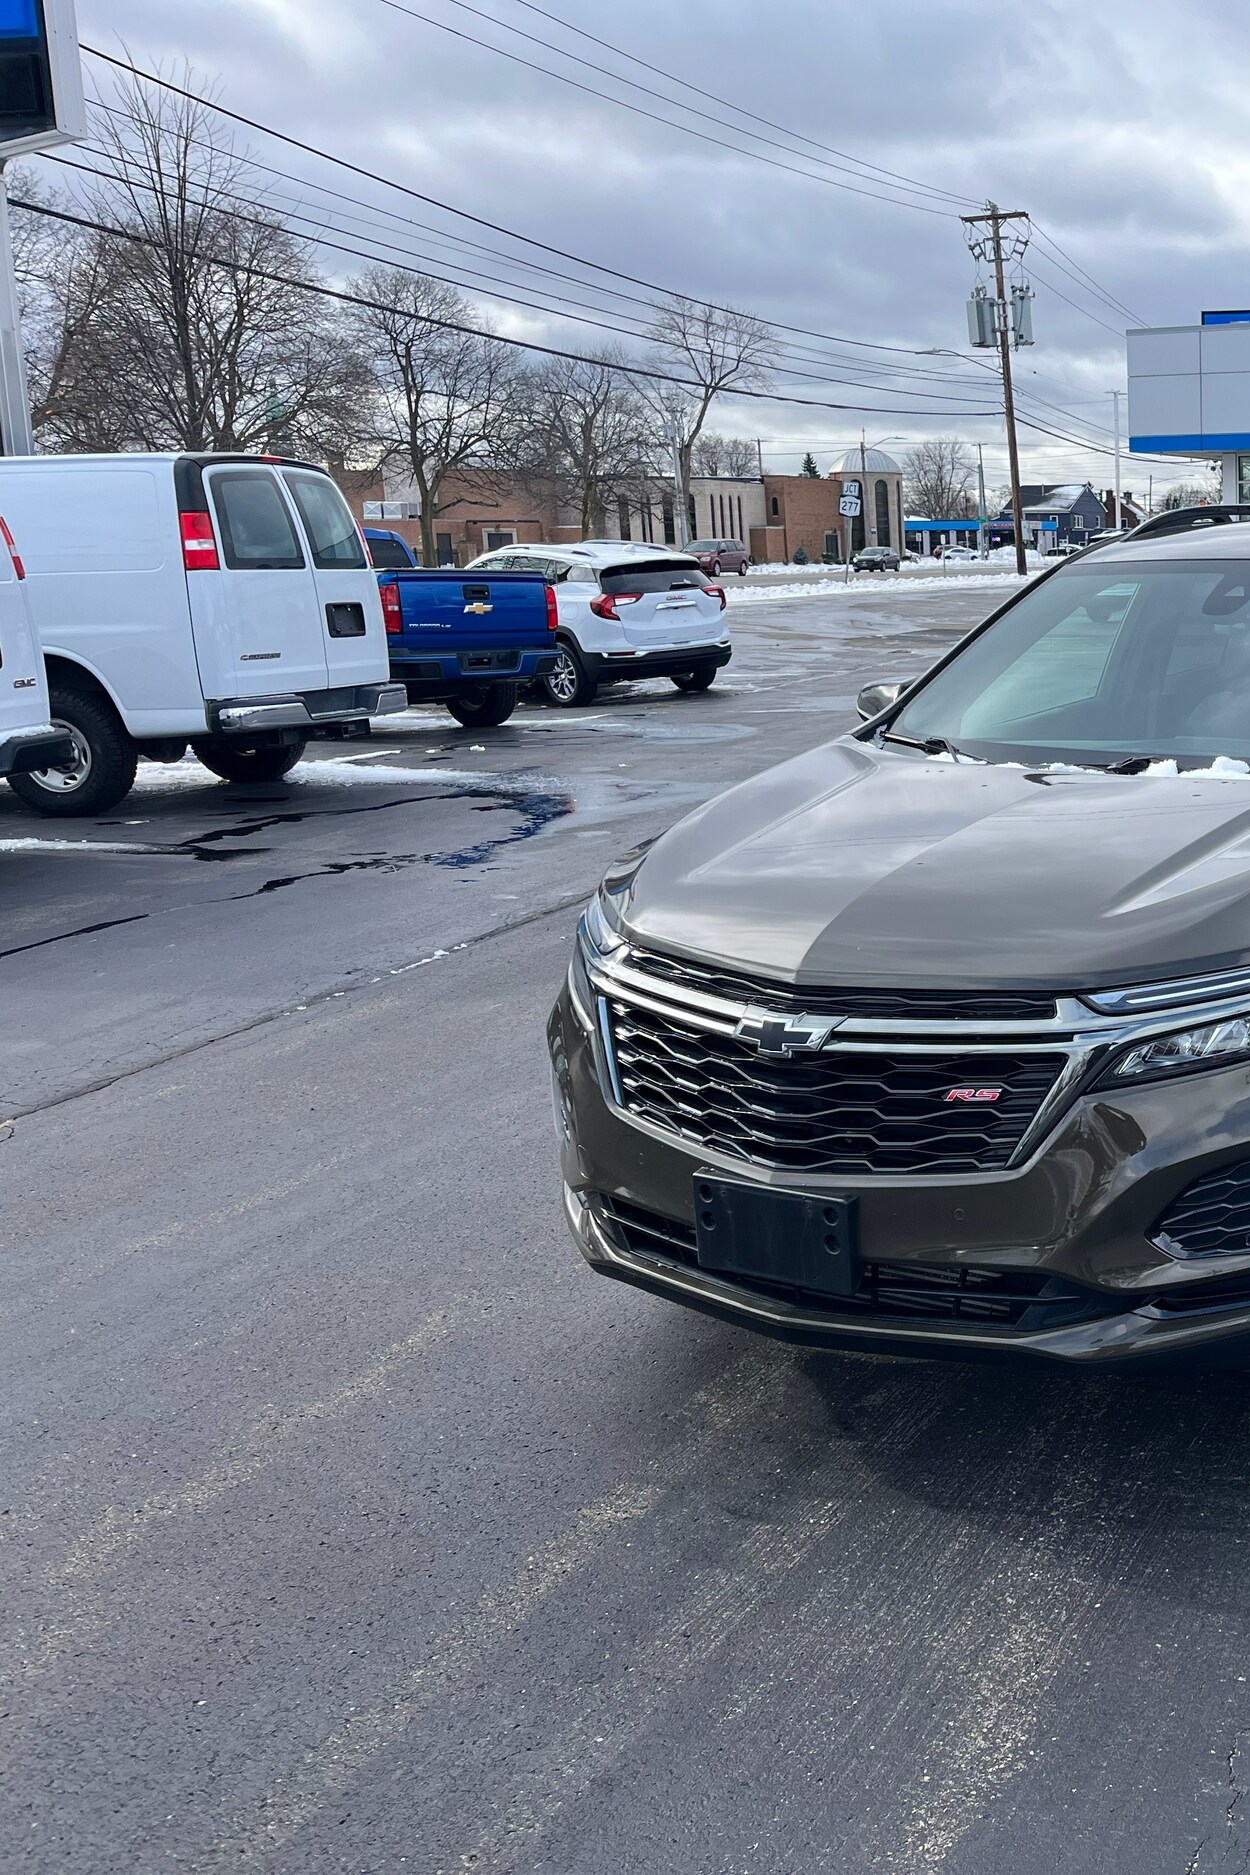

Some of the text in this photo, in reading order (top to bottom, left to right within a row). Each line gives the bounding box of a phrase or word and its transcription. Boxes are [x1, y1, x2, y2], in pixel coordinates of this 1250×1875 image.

[845, 484, 857, 494] JCT
[841, 500, 859, 512] 277
[14, 678, 36, 689] GMC
[944, 1088, 1003, 1102] RS
